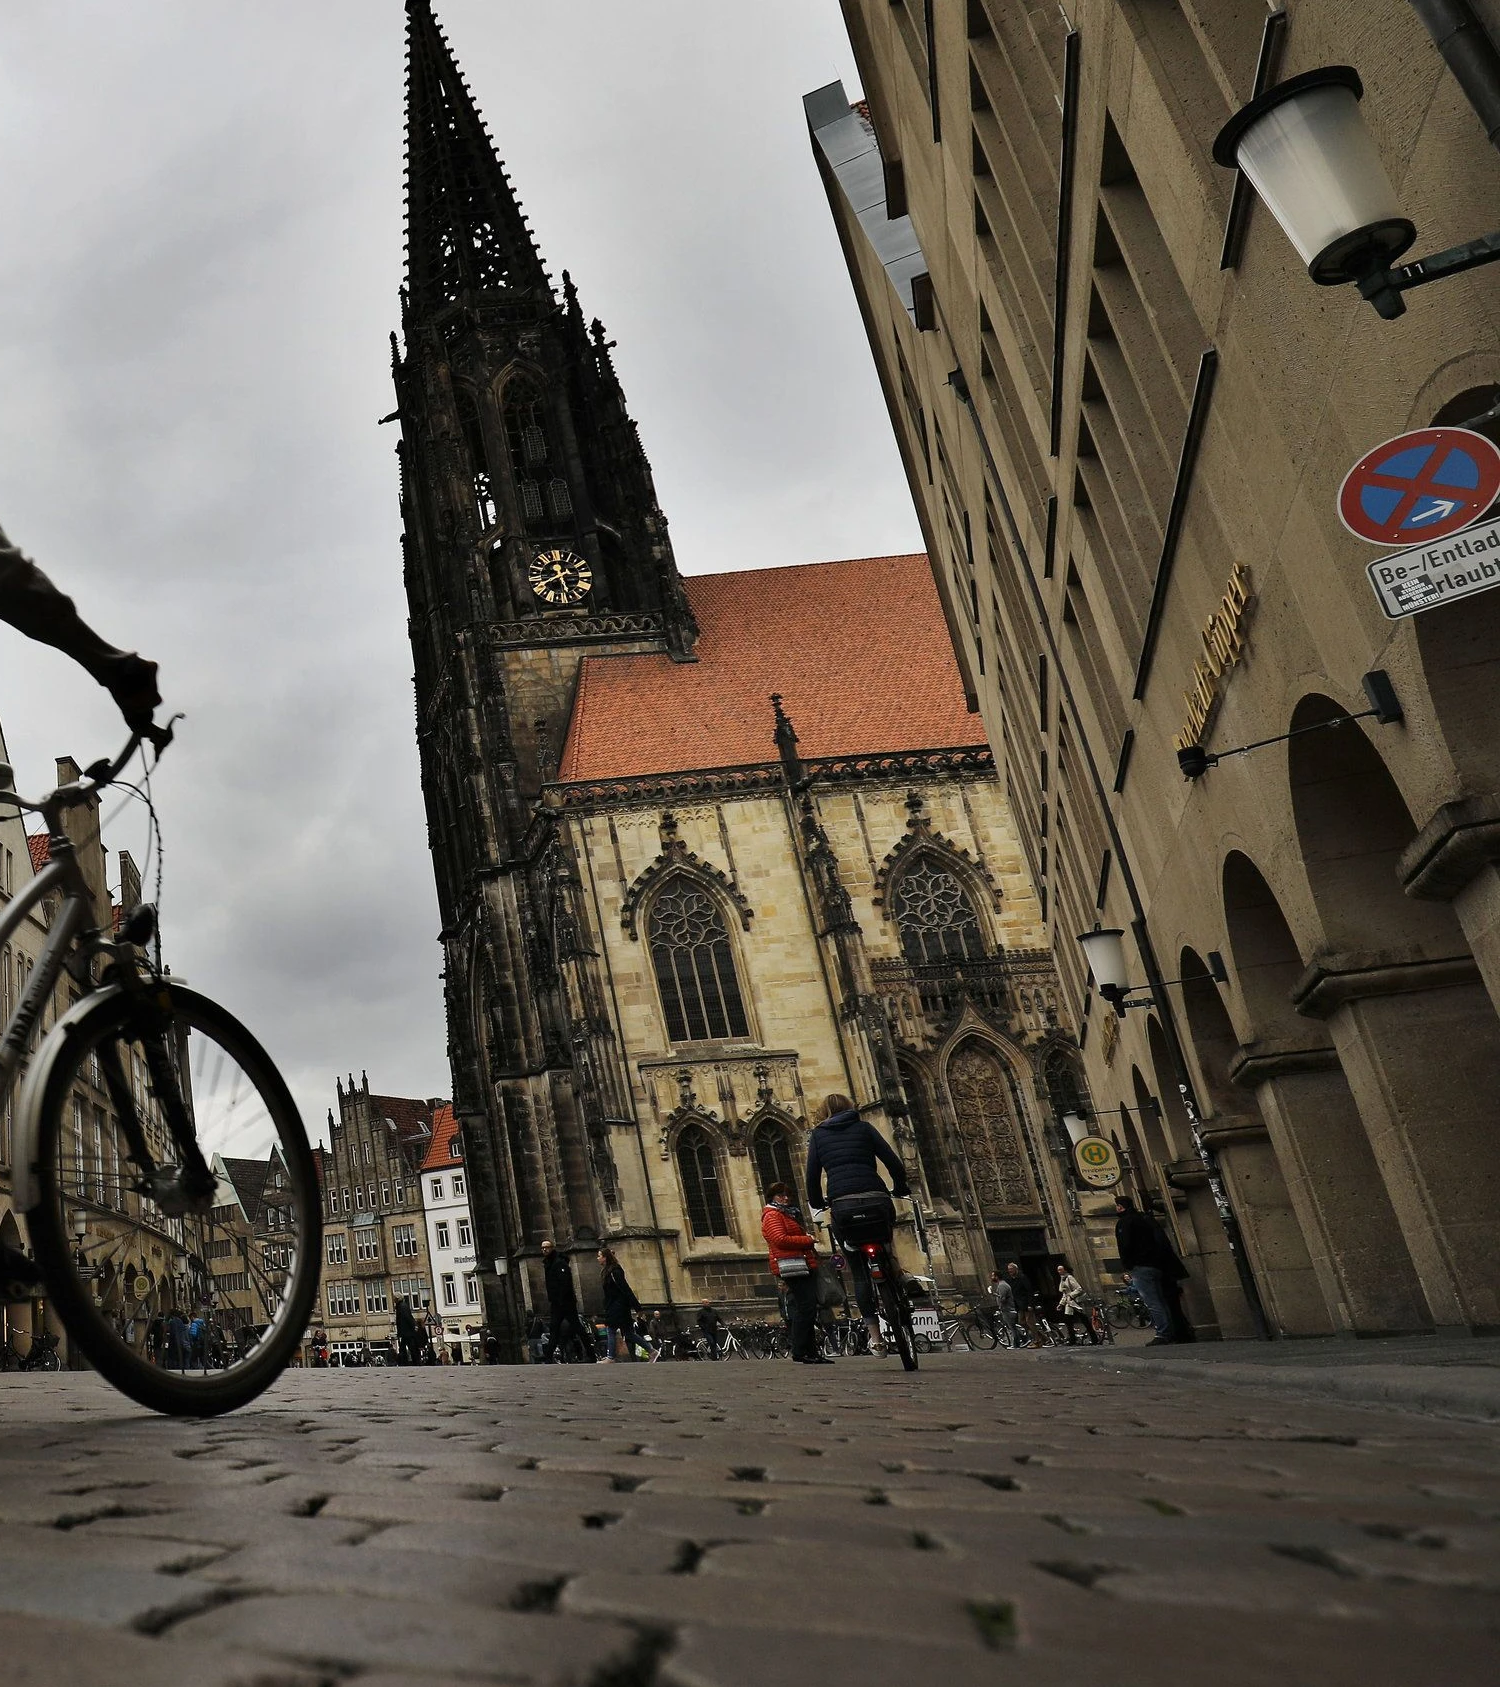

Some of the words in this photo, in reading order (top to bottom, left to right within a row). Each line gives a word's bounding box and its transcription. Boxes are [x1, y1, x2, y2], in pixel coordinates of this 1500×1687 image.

[1435, 558, 1500, 594] rlaubt
[1401, 578, 1420, 590] KEIN
[1401, 582, 1426, 595] STADION
[1411, 593, 1424, 601] VON
[1088, 1147, 1102, 1162] H
